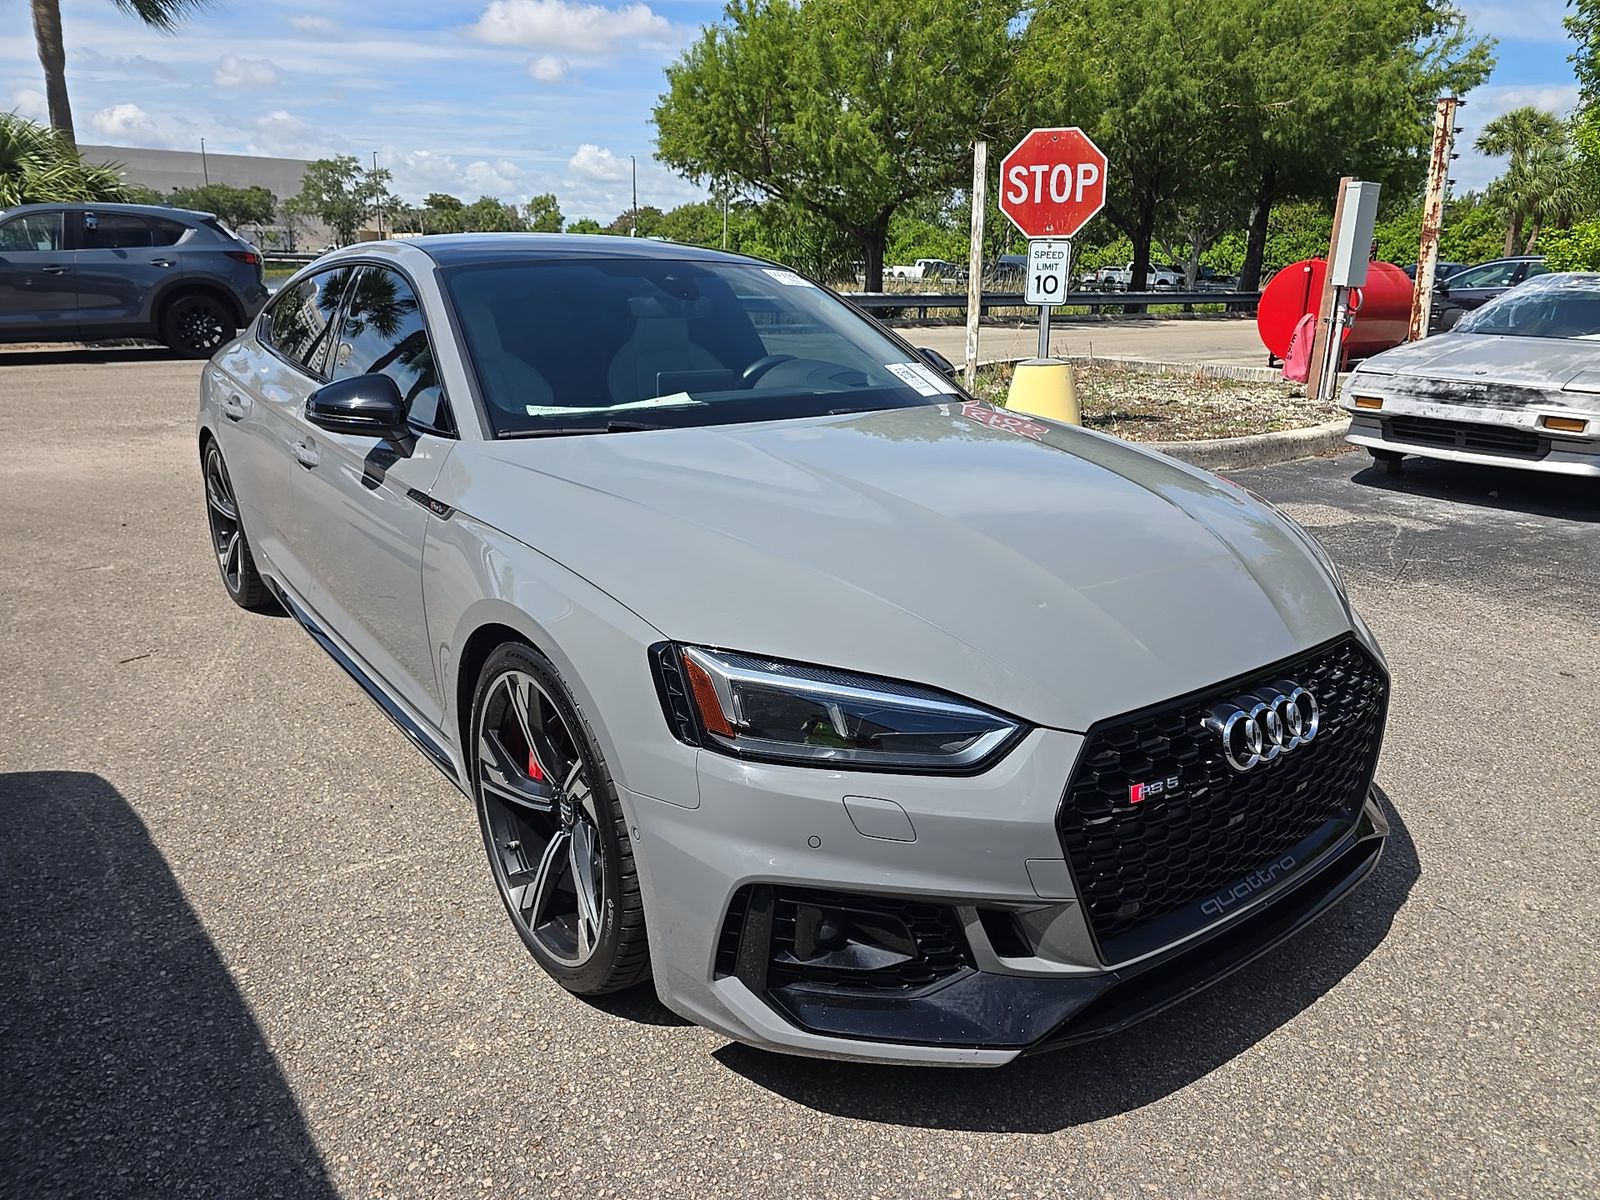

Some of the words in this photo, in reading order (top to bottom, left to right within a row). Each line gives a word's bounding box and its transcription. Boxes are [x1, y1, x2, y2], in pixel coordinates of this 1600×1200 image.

[1006, 163, 1099, 205] STOP
[1033, 250, 1065, 260] SPEED
[1036, 262, 1060, 271] LIMIT
[1034, 275, 1058, 295] 10
[1200, 856, 1296, 915] quattro
